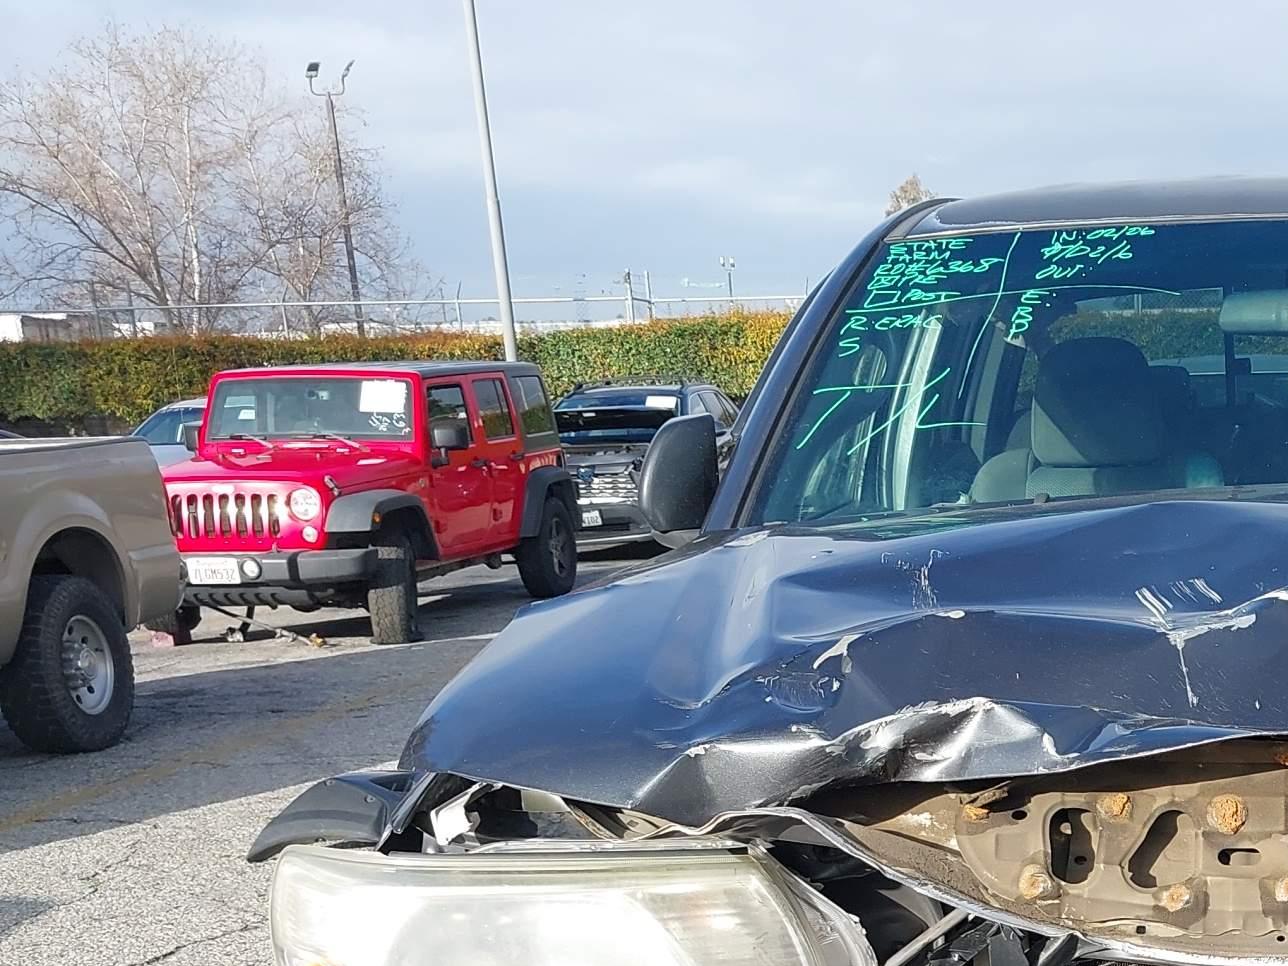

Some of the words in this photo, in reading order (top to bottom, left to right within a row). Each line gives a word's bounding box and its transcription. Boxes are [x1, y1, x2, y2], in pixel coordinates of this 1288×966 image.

[889, 238, 974, 254] STATE
[886, 250, 951, 263] FARM
[838, 336, 861, 358] S
